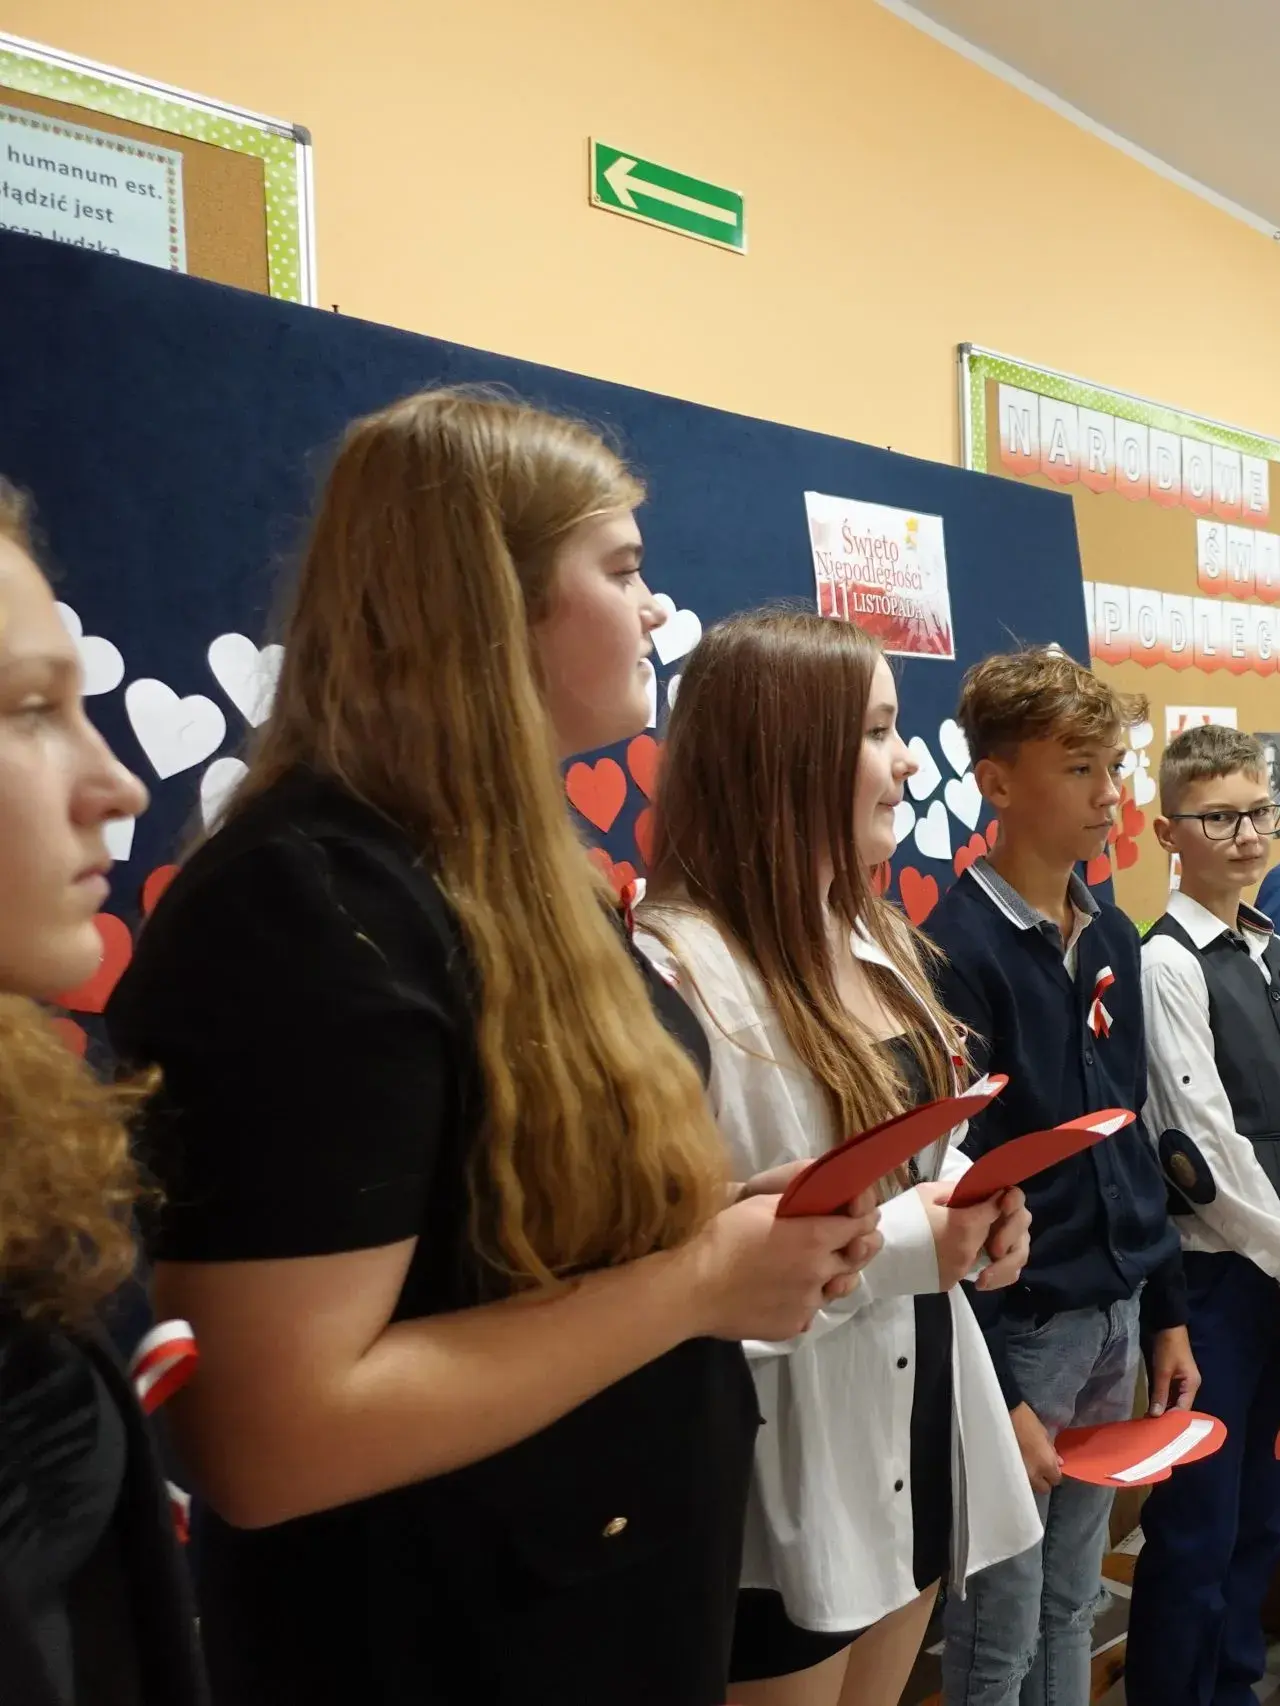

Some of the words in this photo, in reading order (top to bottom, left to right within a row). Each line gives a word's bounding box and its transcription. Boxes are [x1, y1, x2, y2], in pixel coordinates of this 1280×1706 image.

[8, 144, 118, 189] humanum
[125, 180, 163, 199] est.
[0, 181, 68, 212] łądzić
[74, 198, 114, 223] jest
[1008, 405, 1264, 512] NARODOWE
[841, 518, 899, 565] Święto
[816, 551, 923, 592] Niepodległości
[853, 592, 926, 620] LISTOPADA
